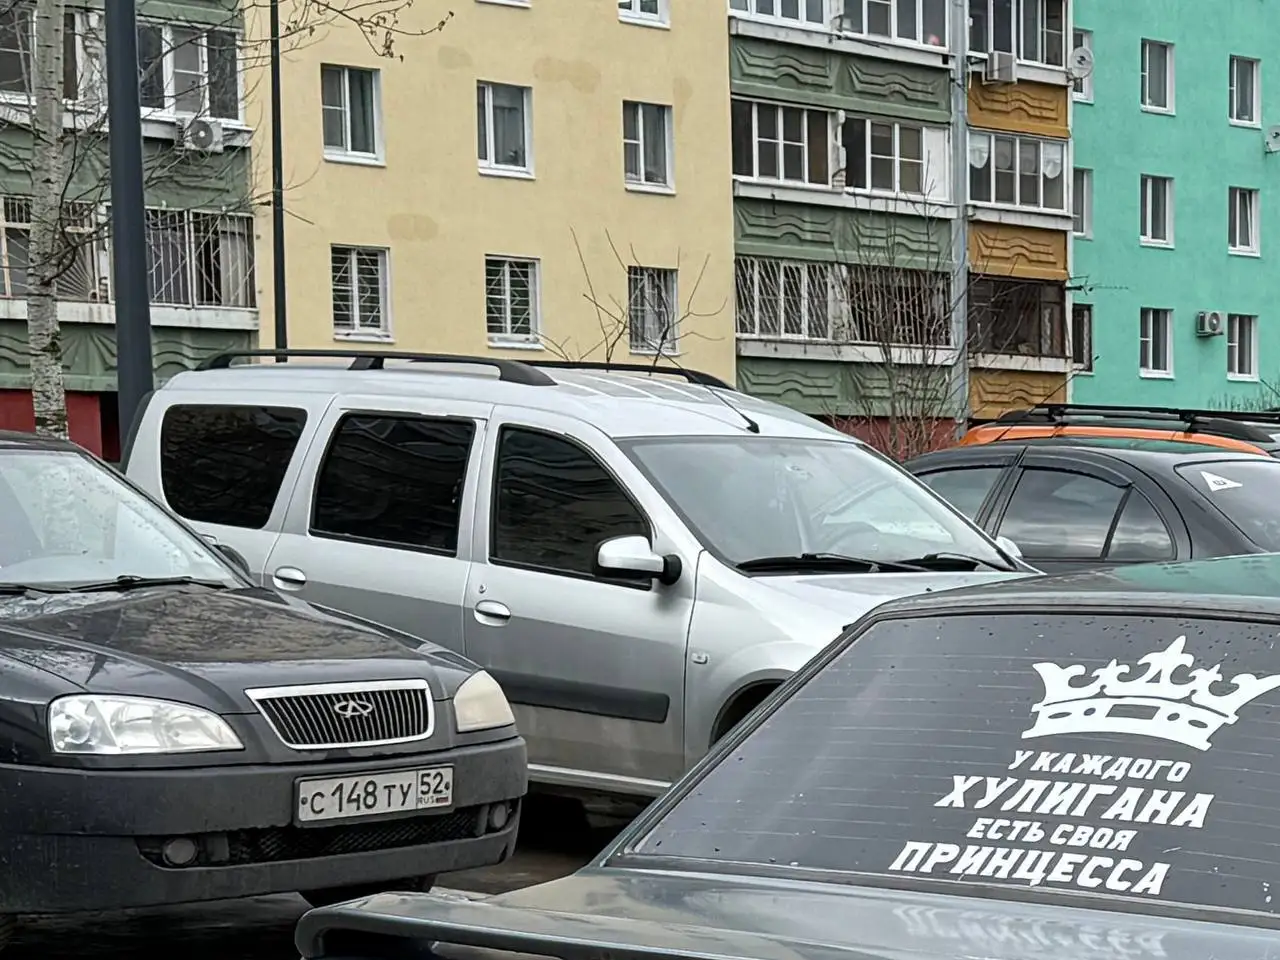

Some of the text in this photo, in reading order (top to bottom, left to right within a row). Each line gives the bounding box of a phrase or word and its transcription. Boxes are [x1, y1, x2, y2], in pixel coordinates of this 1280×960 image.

[420, 772, 444, 795] 52
[1008, 750, 1191, 783] У КАЖДОГО
[934, 774, 1215, 829] ХУЛИГАНА
[966, 817, 1138, 851] ЕСТЬ СВОЯ
[888, 840, 1171, 896] ПРИНЦЕССА
